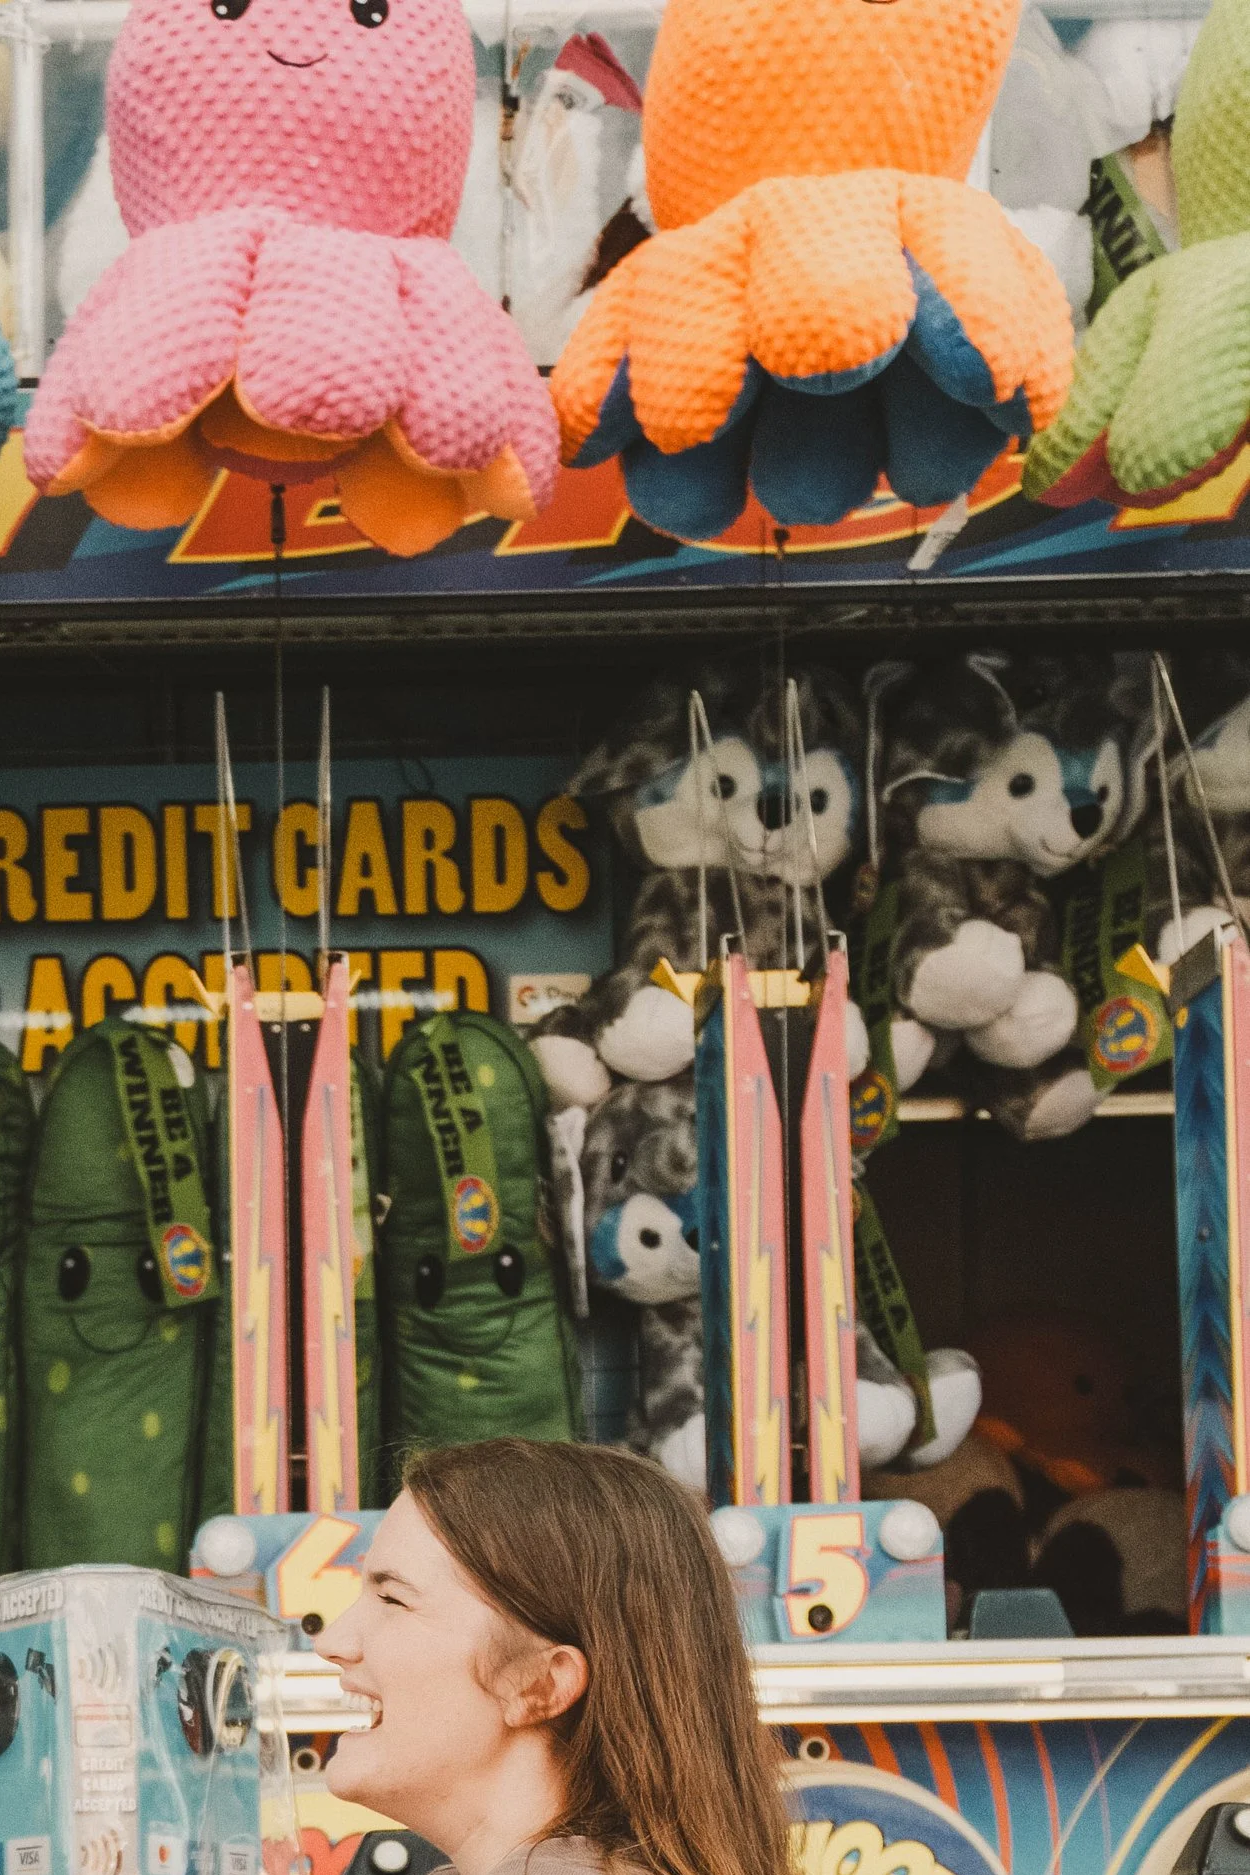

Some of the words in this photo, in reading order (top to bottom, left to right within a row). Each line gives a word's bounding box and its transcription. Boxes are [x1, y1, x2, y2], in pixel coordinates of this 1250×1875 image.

[272, 796, 592, 918] CARDS
[118, 1035, 175, 1226] WINNER
[160, 1087, 190, 1142] BE
[440, 1042, 473, 1095] BE
[459, 1108, 484, 1134] A
[173, 1153, 194, 1183] A
[781, 1511, 872, 1638] 5
[18, 1850, 41, 1866] VISA
